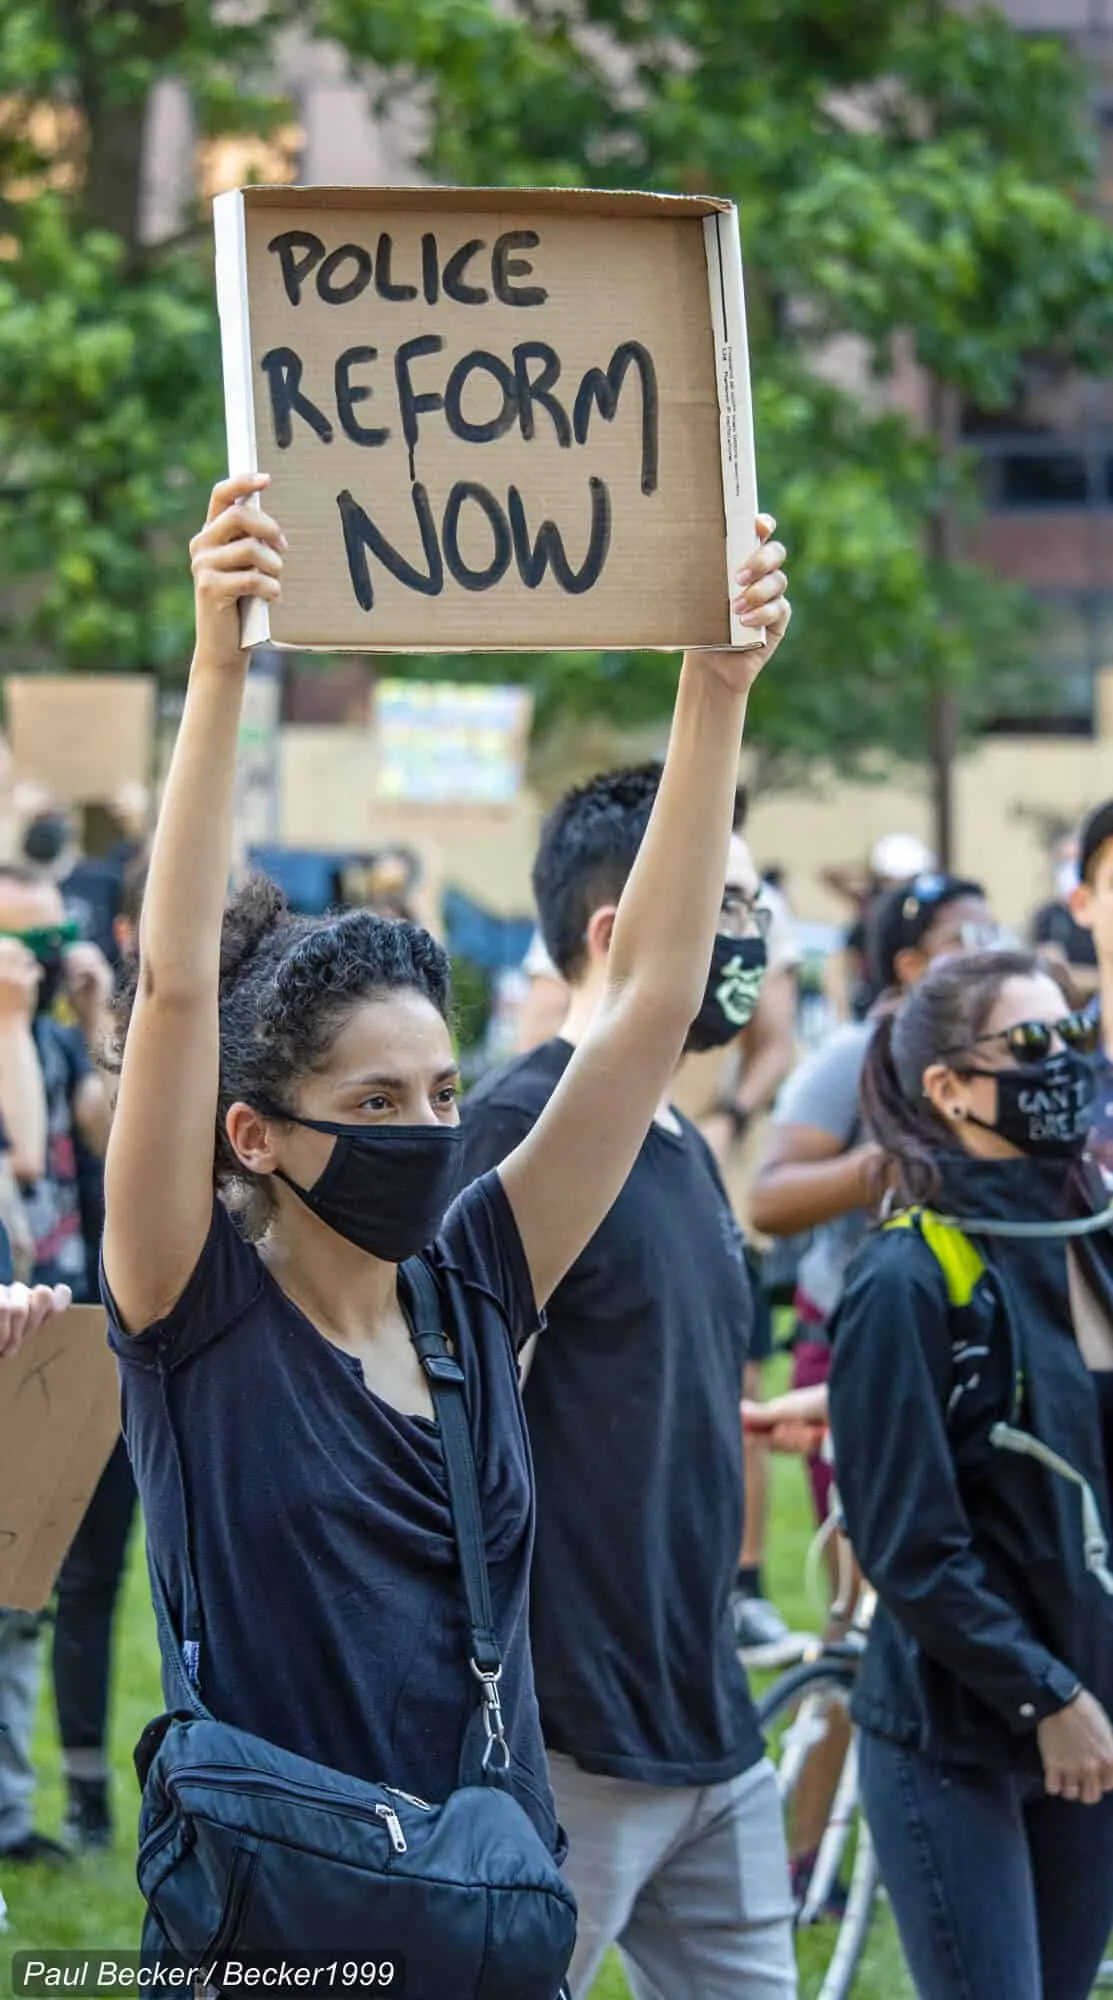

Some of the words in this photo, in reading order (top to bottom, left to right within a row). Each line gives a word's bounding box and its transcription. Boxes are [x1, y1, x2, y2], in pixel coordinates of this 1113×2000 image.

[267, 230, 550, 307] POLICE
[260, 334, 659, 497] REFORM
[336, 476, 612, 613] NOW
